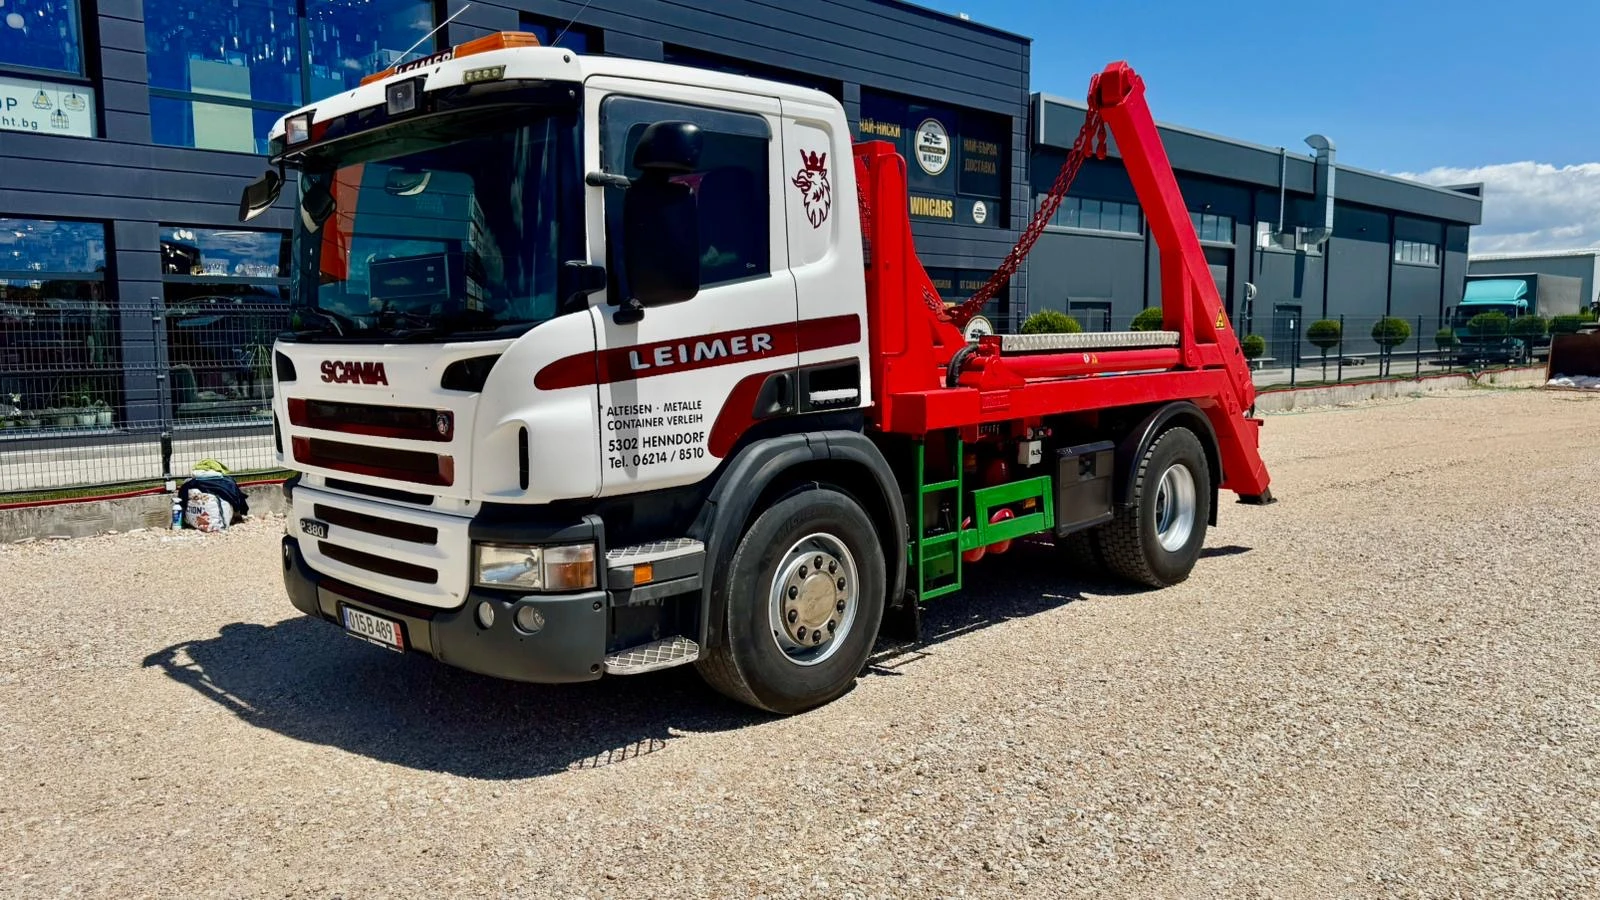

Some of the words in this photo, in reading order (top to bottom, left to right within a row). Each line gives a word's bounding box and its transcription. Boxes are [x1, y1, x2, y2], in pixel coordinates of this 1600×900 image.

[922, 154, 943, 164] WINCARS
[910, 196, 953, 219] WINCARS
[629, 333, 773, 370] LEIMER
[320, 360, 389, 386] SCANIA
[607, 404, 652, 417] ALTEISEN
[663, 400, 702, 412] METALLE
[607, 415, 664, 430] CONTAINER
[667, 414, 703, 426] VERLEIH
[608, 438, 638, 452] 5302
[643, 431, 705, 448] HENNDORF
[609, 456, 628, 469] Tel.
[633, 451, 667, 466] 06214
[679, 447, 704, 460] 8510
[306, 522, 324, 537] 380
